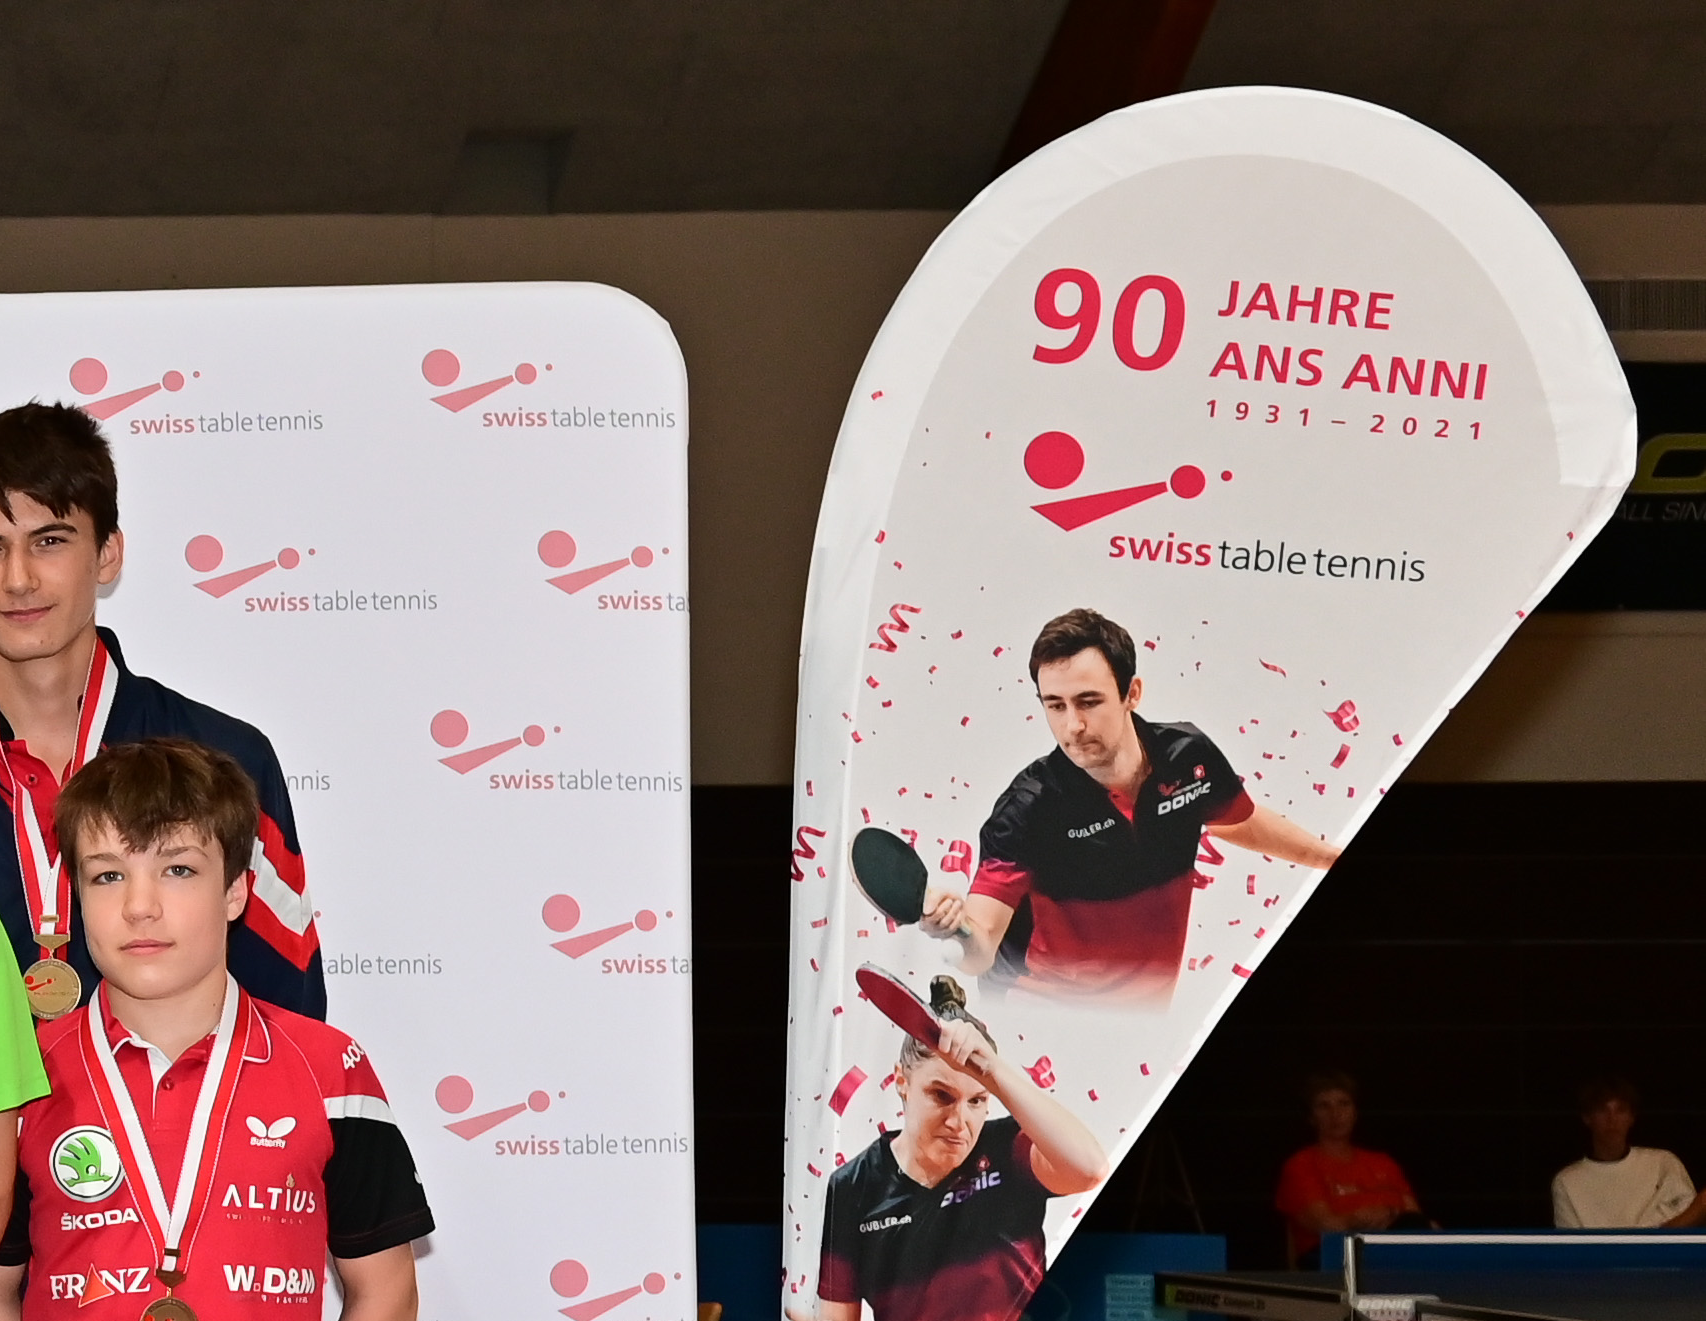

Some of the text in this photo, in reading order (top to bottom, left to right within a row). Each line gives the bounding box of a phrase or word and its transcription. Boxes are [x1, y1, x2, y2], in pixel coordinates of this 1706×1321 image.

[1033, 268, 1186, 371] 90
[1217, 280, 1394, 331] JAHRE
[1209, 342, 1487, 400] ANS ANNI
[1109, 532, 1426, 582] swiss table tennis
[61, 1207, 139, 1231] ŠKODA
